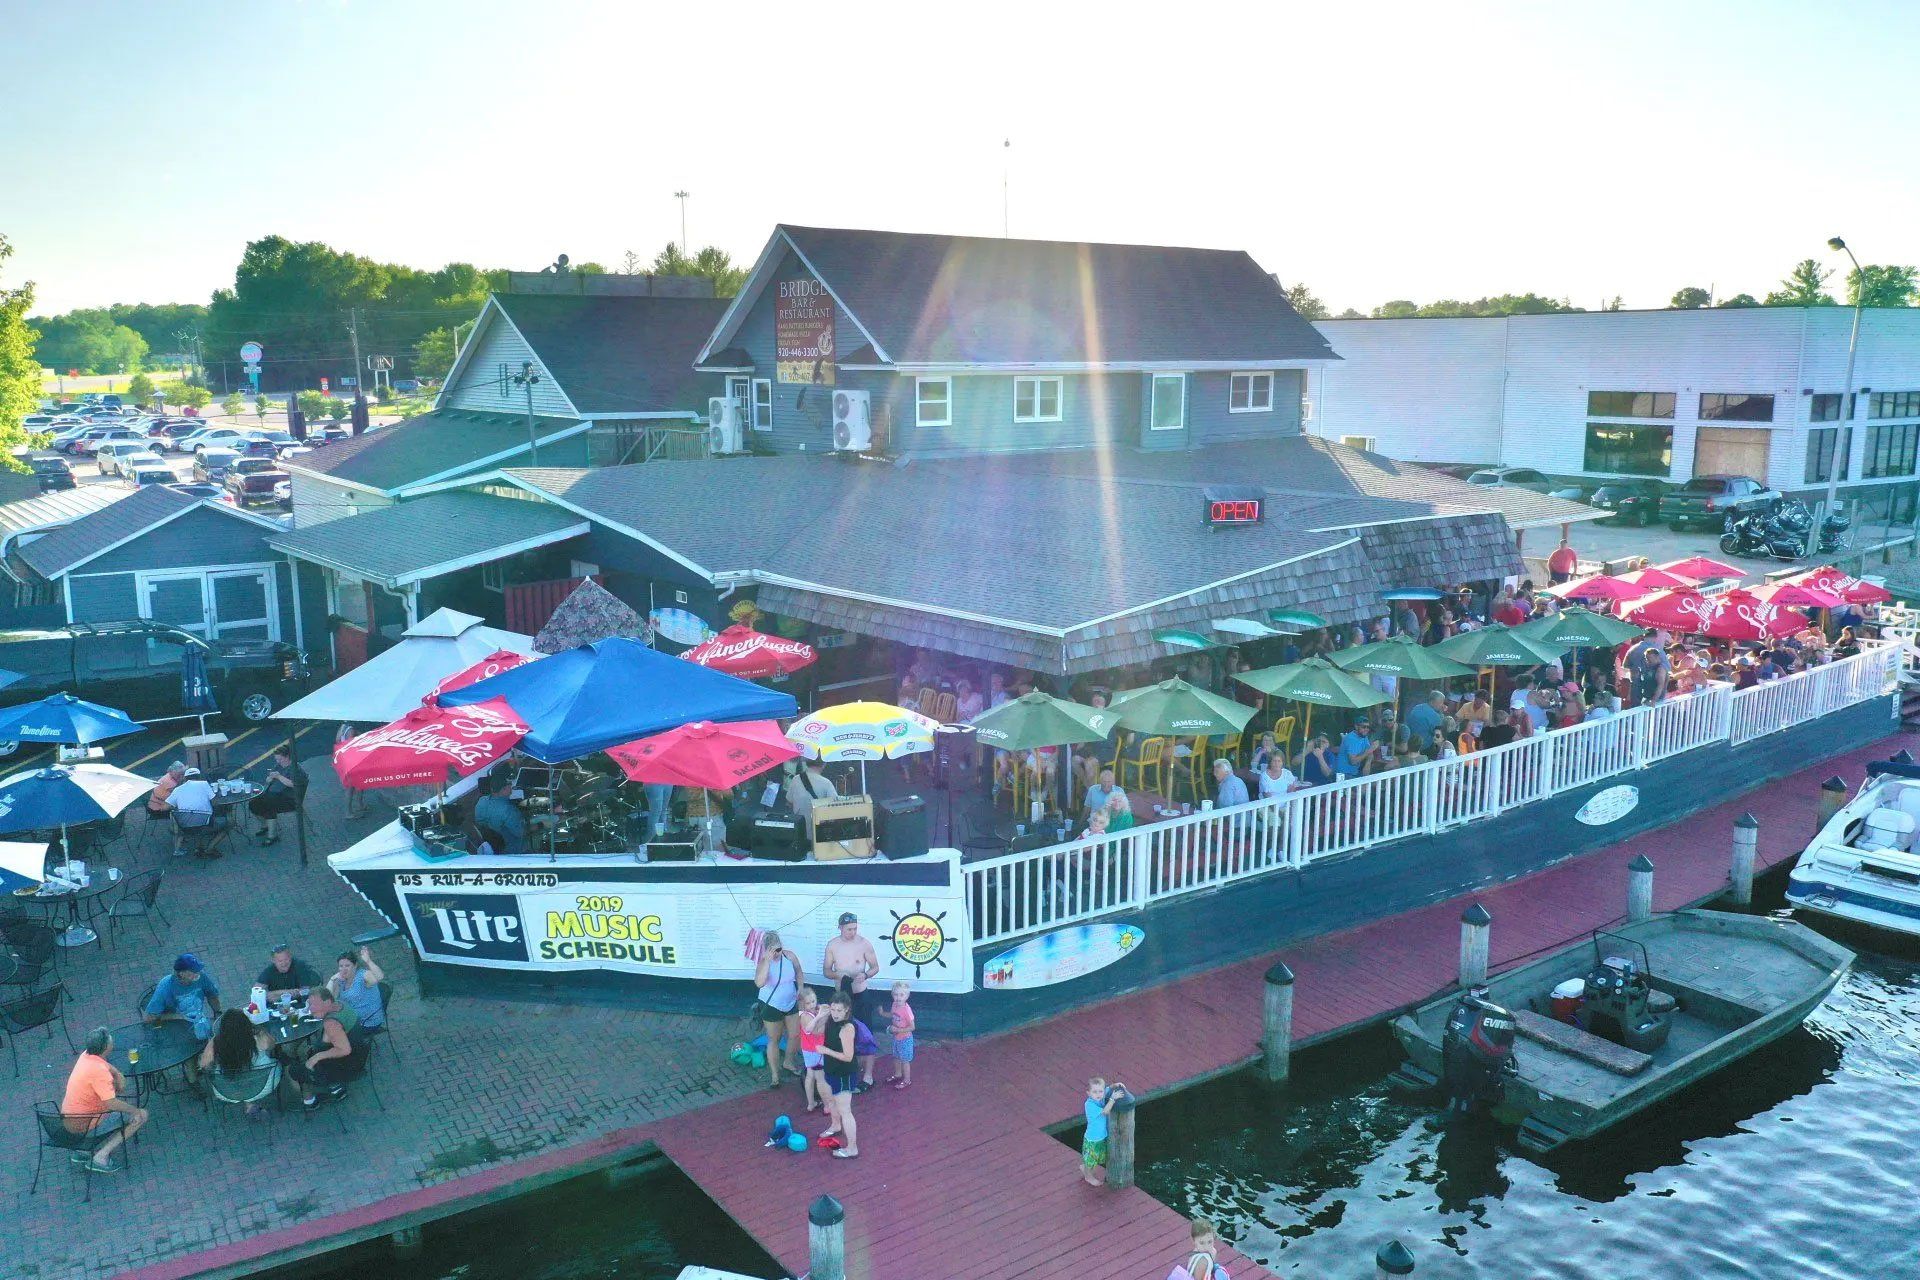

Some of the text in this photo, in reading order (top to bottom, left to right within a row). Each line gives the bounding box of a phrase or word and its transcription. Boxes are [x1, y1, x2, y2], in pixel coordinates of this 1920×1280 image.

[791, 298, 816, 308] BAR &
[780, 308, 830, 319] RESTAURANT
[778, 348, 818, 356] 920-446-3300
[1211, 502, 1256, 520] OPEN
[1364, 663, 1402, 672] JAMESON
[1292, 689, 1332, 700] JAMESON
[1171, 719, 1212, 728] JAMESON
[976, 727, 1009, 740] JAMESON
[363, 776, 382, 784] JOIN
[576, 896, 623, 912] 2019
[430, 907, 519, 950] Lite
[546, 911, 663, 942] MUSIC
[899, 924, 937, 939] Bridge
[540, 940, 676, 964] SCHEDULE
[910, 941, 940, 960] RESTAURANT
